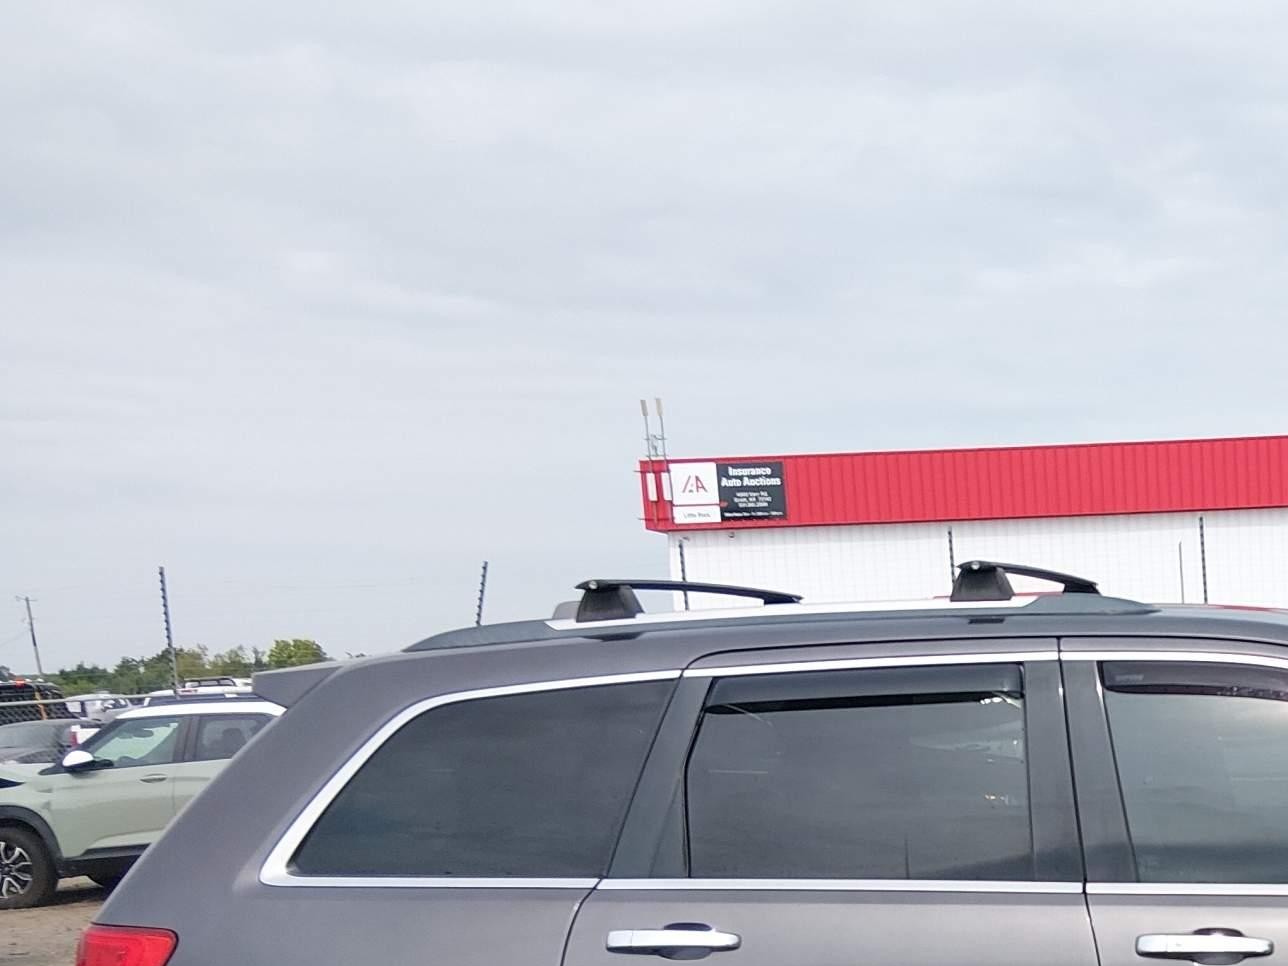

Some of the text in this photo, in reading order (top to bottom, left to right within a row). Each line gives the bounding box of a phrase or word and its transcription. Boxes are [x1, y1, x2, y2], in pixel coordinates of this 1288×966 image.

[728, 466, 771, 476] Insurance
[721, 476, 781, 487] Auto Auctions
